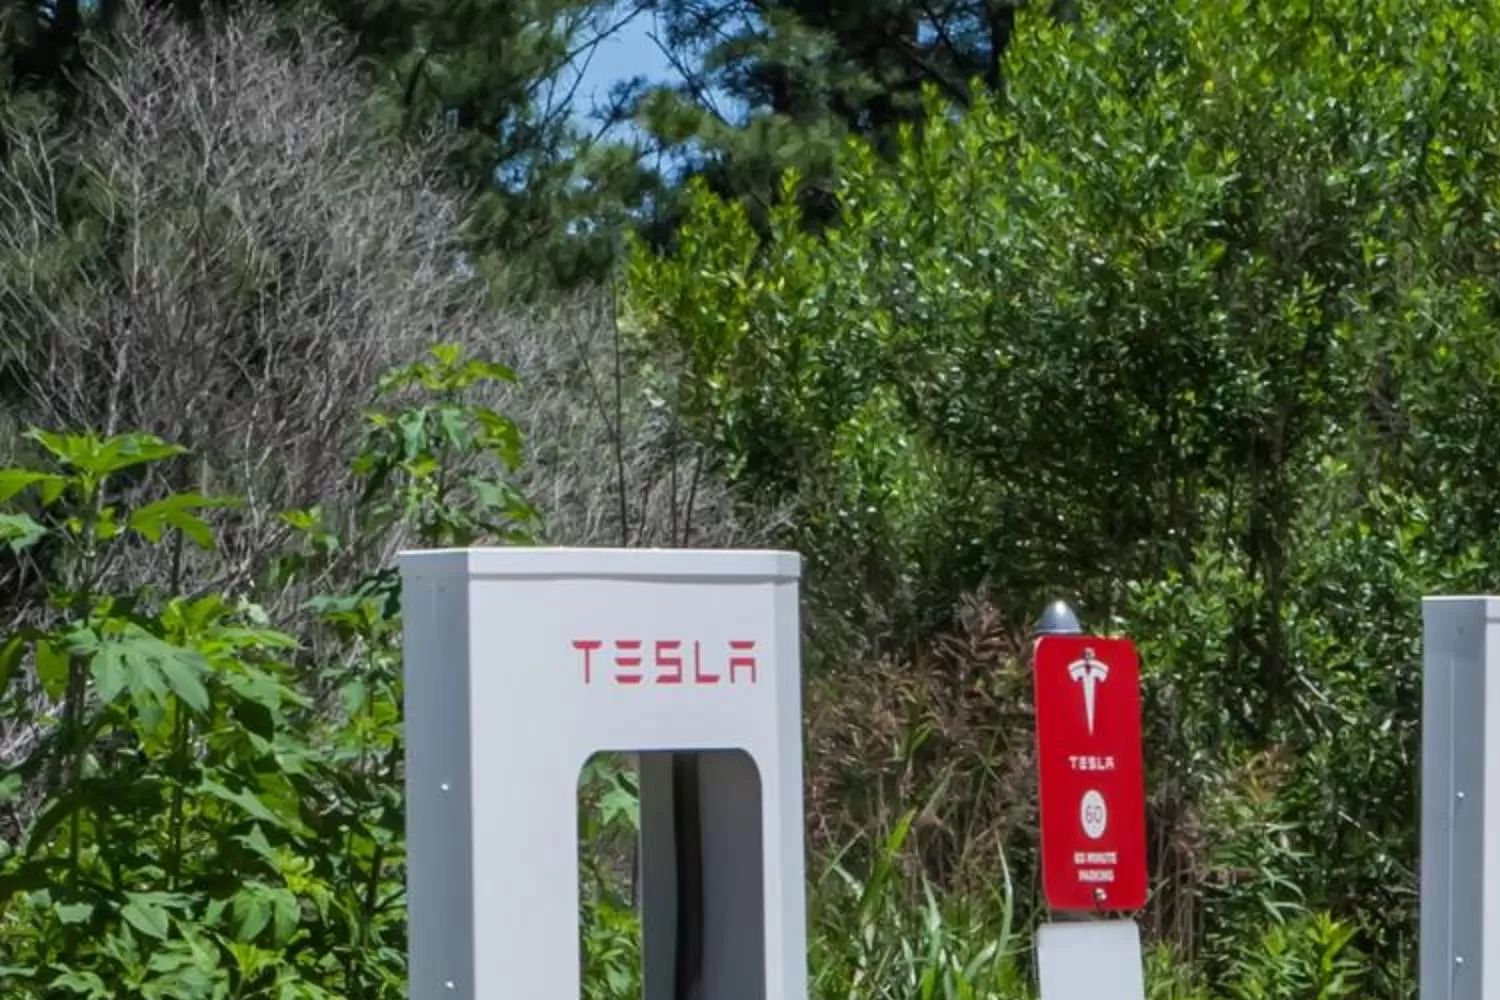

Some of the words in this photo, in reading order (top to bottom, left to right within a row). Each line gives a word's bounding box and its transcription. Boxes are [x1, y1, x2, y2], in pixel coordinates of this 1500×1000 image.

[571, 639, 757, 685] TESLA
[1068, 755, 1116, 771] TESLA
[1085, 803, 1104, 825] 60
